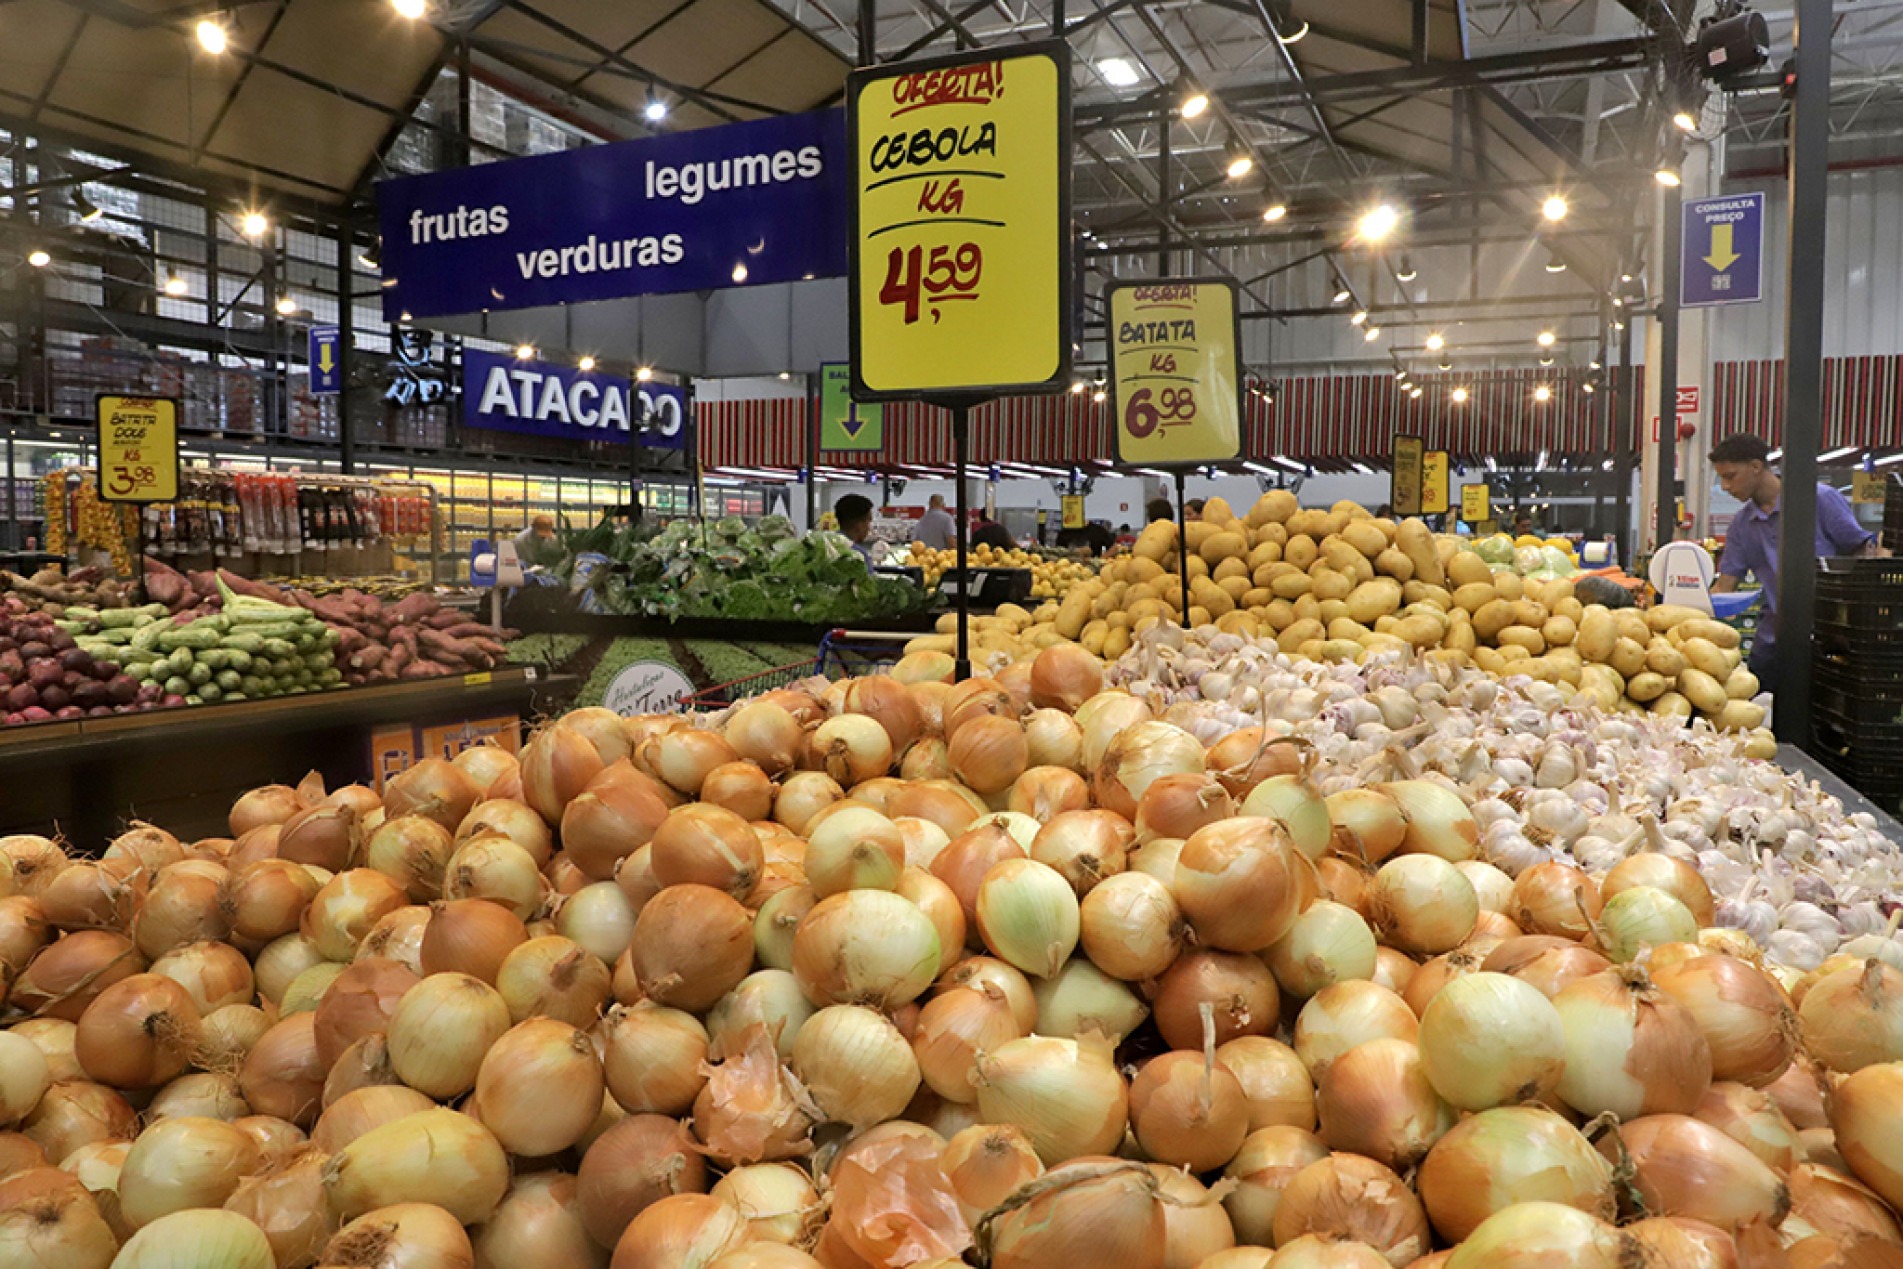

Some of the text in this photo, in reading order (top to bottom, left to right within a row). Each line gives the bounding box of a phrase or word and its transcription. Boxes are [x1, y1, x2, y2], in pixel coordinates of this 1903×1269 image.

[870, 121, 996, 173] CEBOLA
[645, 145, 823, 204] legumes
[917, 178, 964, 214] KG
[1695, 199, 1755, 213] CONSULTA
[410, 204, 510, 244] frutas
[1706, 212, 1744, 223] PREÇO
[516, 233, 684, 280] verduras
[1118, 319, 1196, 344] BATATA
[1150, 353, 1177, 373] KG
[478, 367, 682, 437] ATACADO
